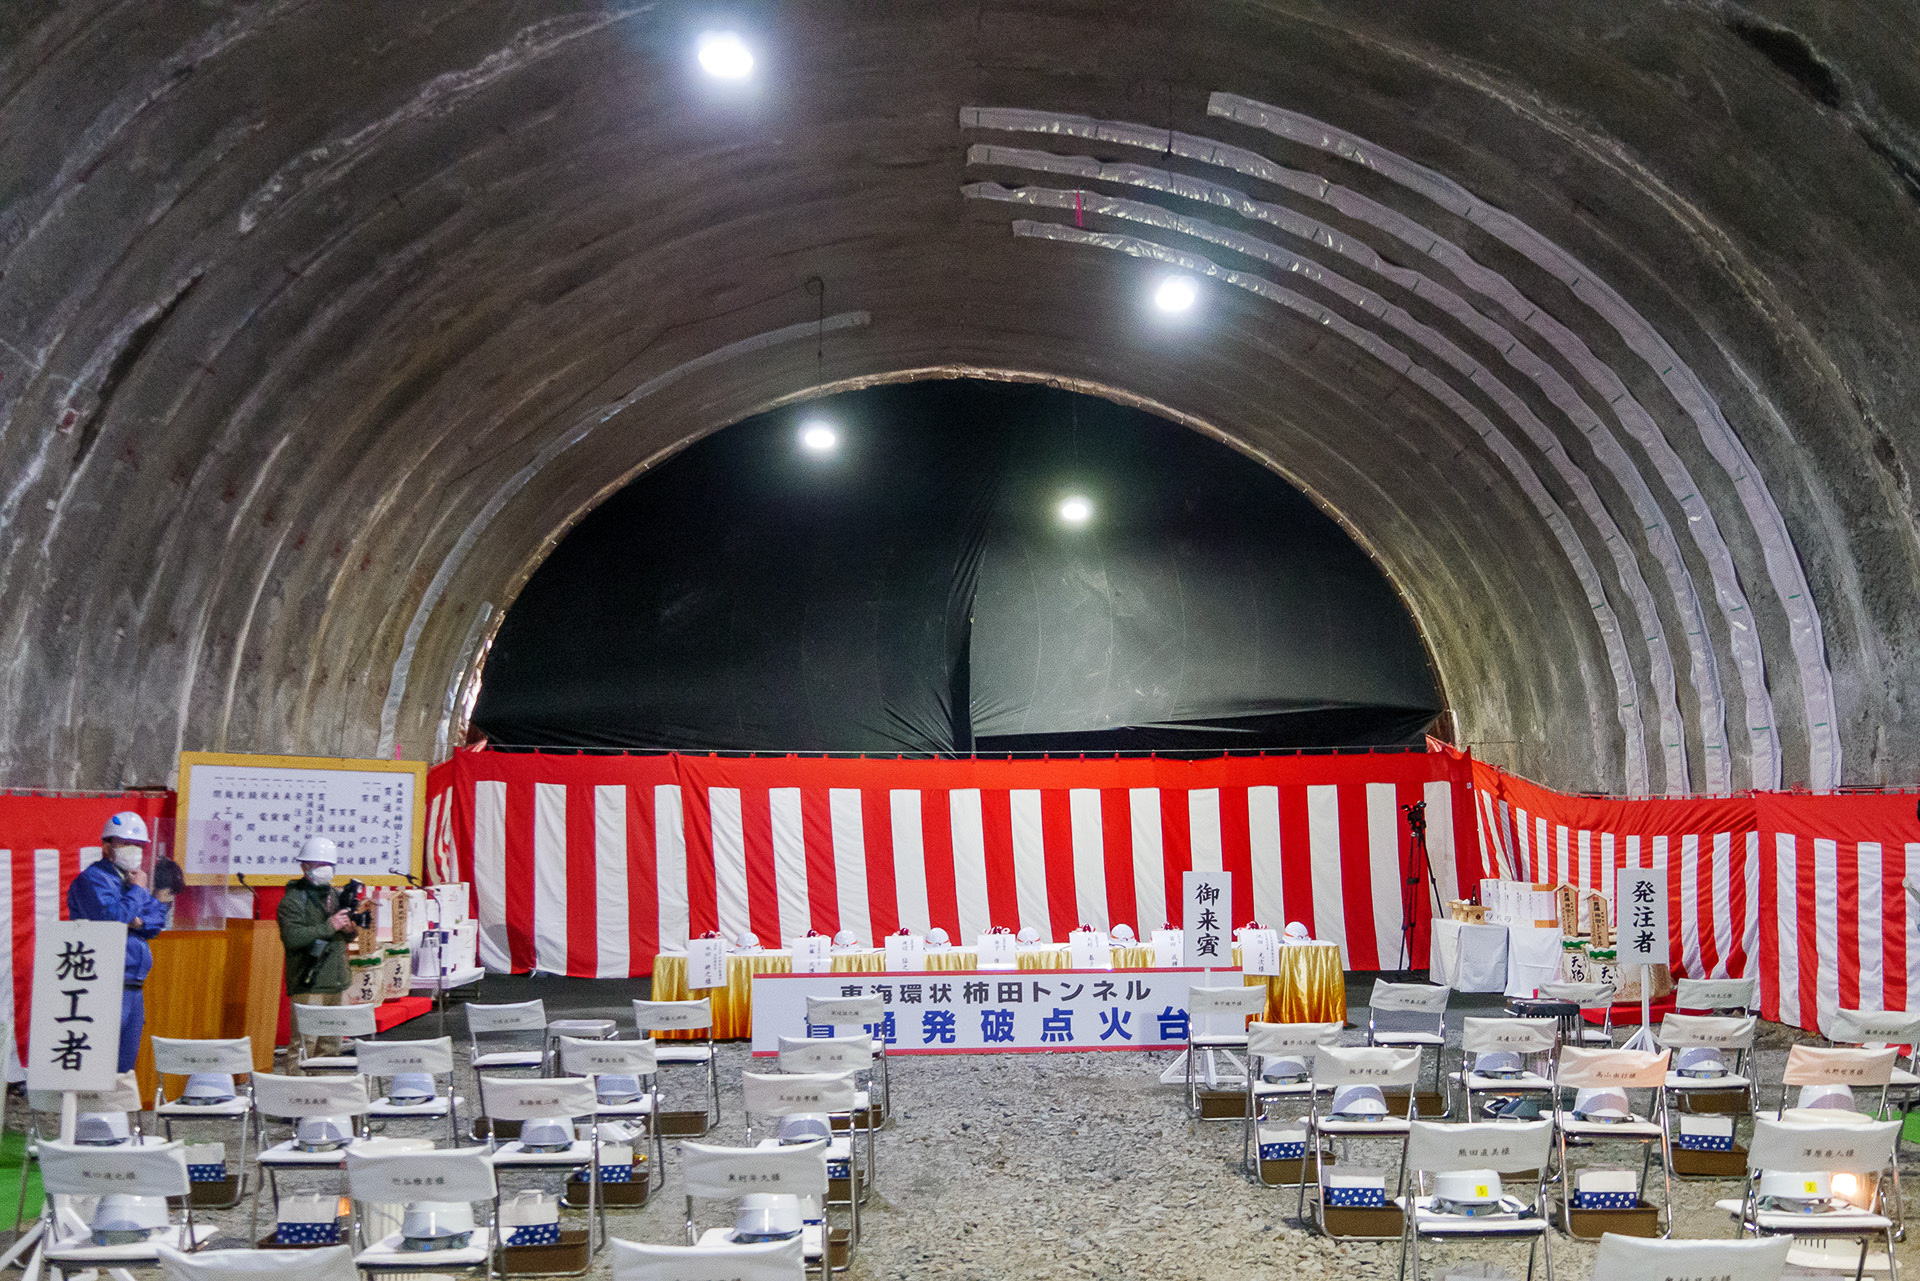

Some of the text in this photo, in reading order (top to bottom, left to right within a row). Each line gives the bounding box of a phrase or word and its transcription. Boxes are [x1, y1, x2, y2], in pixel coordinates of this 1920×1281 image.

[1194, 882, 1221, 957] 御来賓
[1631, 880, 1657, 954] 発注者
[1571, 955, 1585, 983] 天狗
[50, 941, 99, 1072] 施工者
